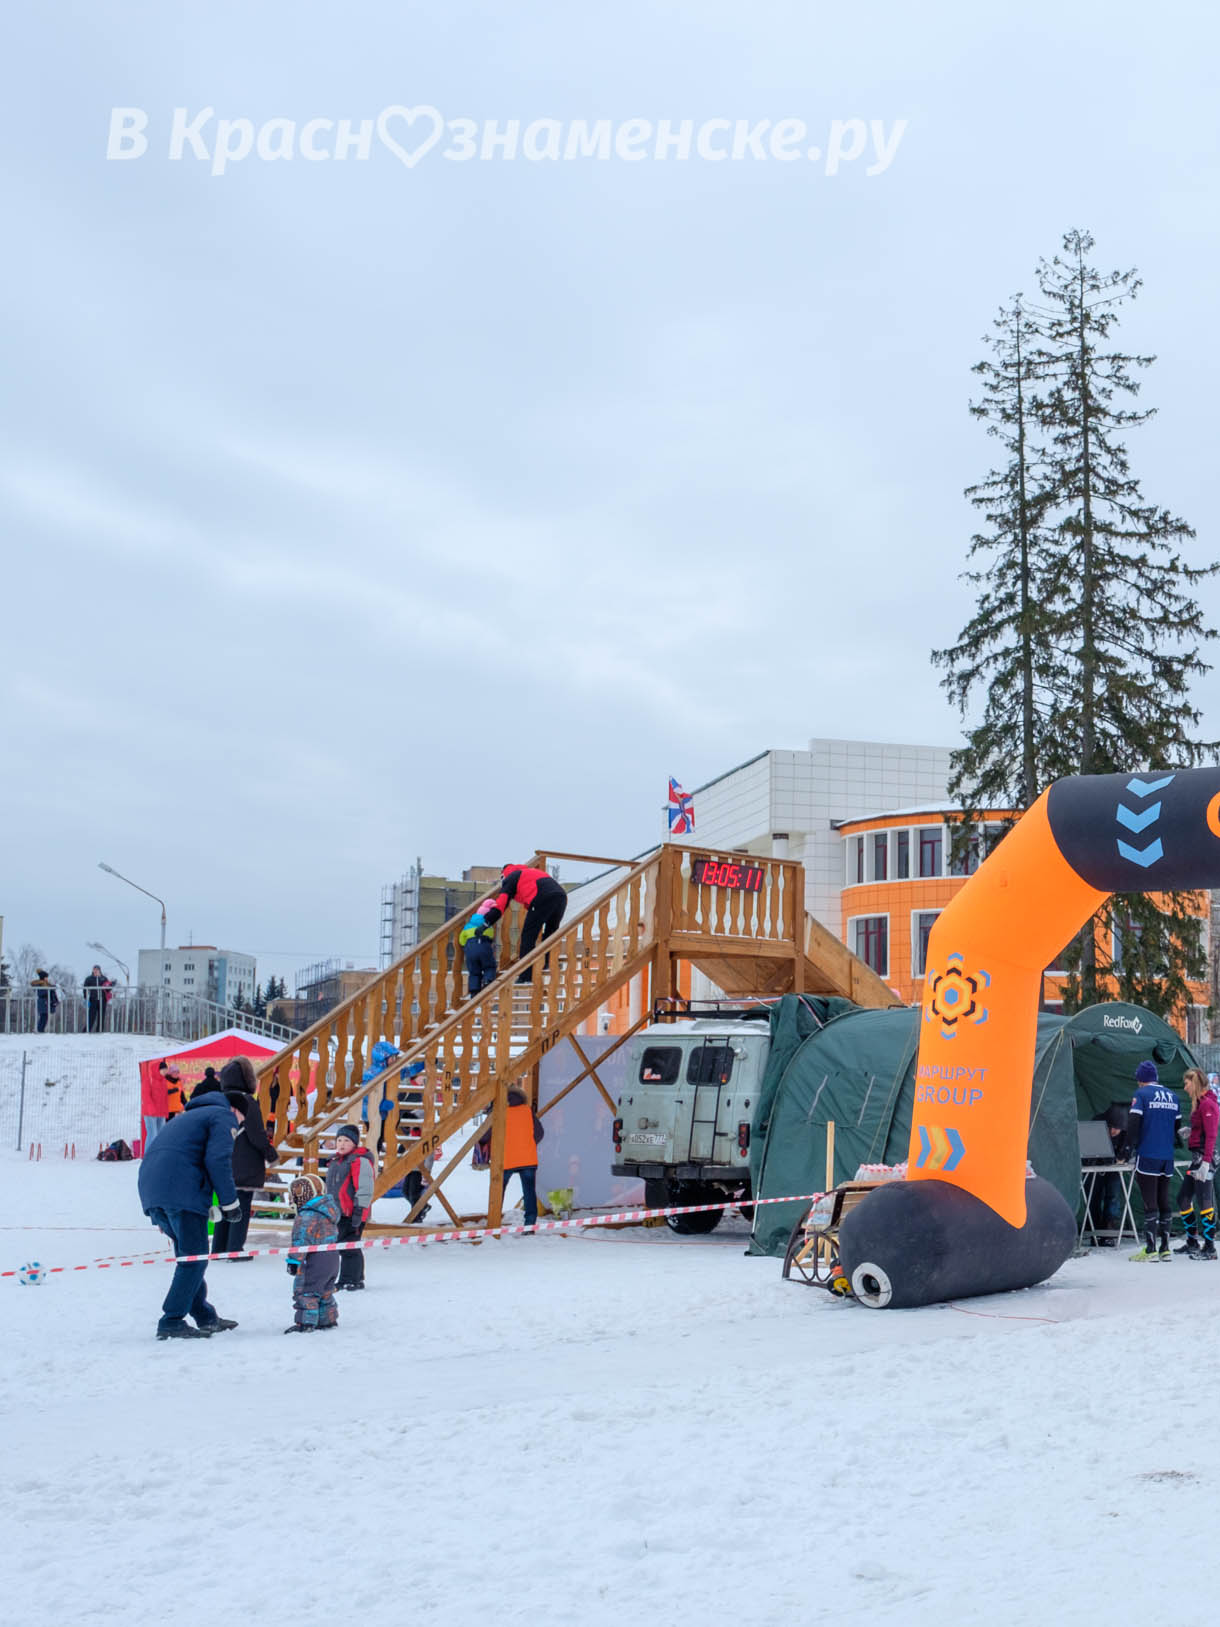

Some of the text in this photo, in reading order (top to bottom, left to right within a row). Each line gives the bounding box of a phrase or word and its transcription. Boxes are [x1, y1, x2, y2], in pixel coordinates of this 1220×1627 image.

[702, 861, 762, 890] 13:05:11
[1103, 1014, 1134, 1030] RedFox
[917, 1086, 984, 1106] GROUP
